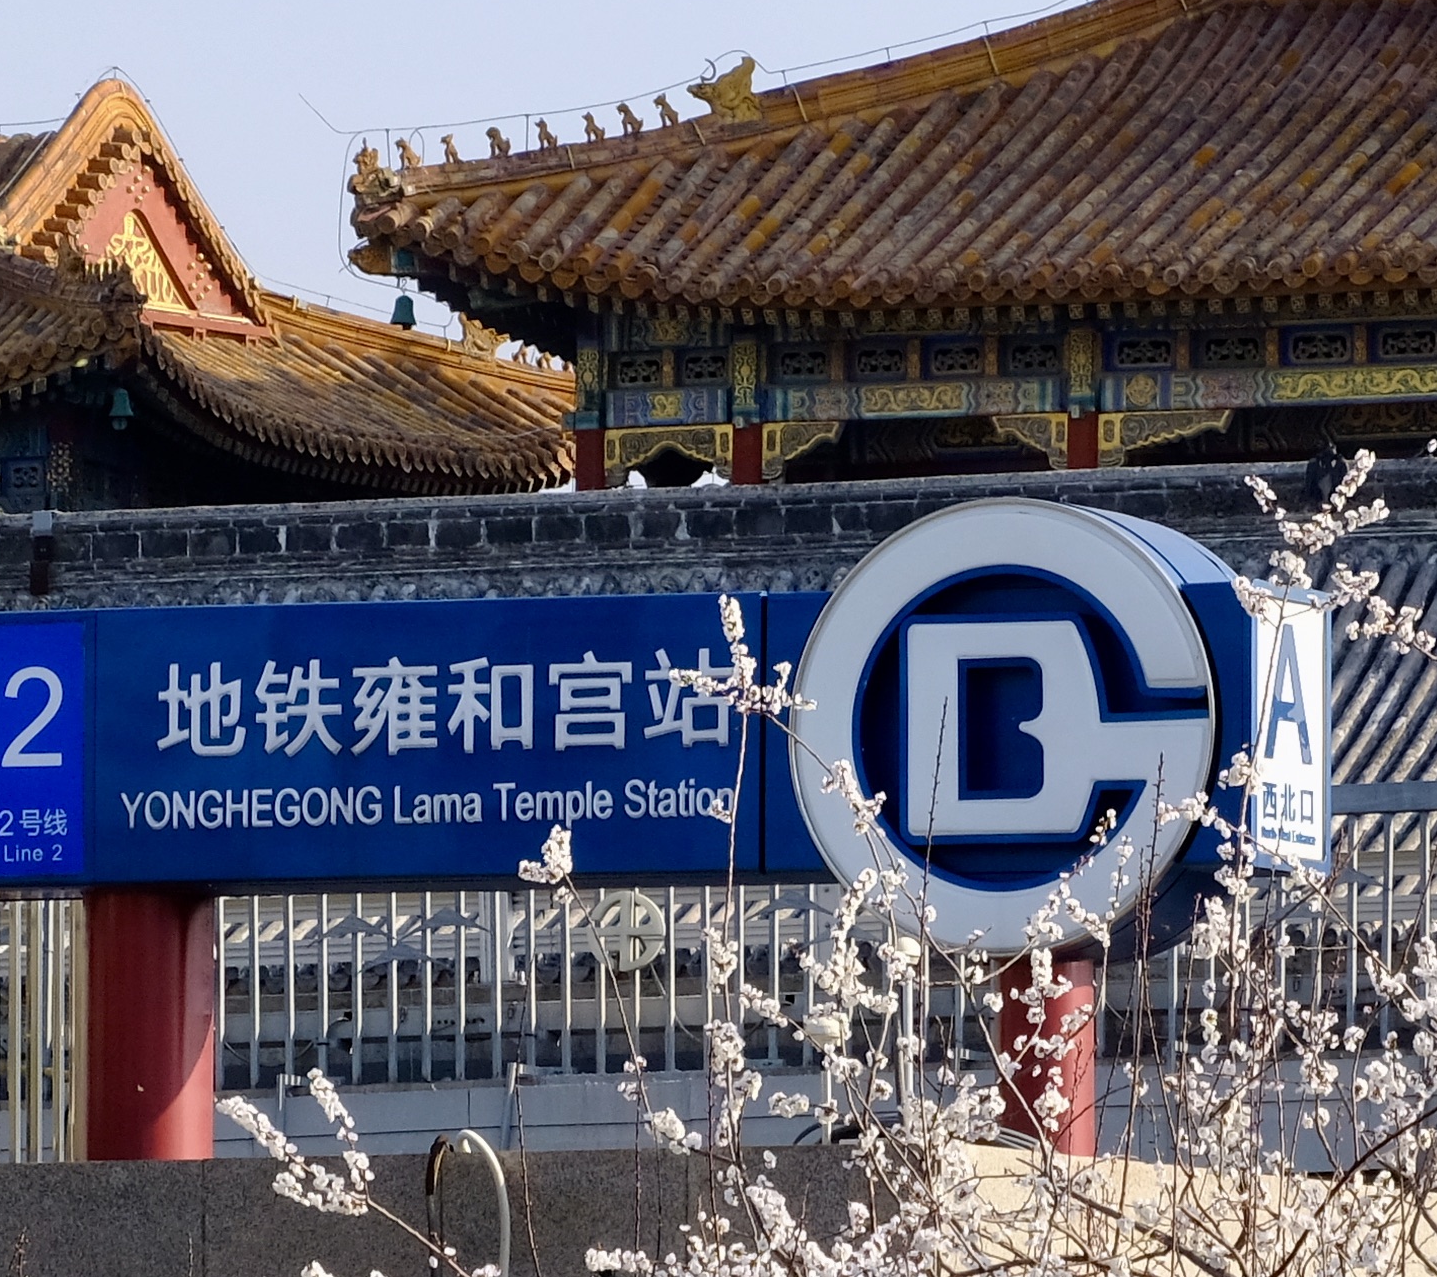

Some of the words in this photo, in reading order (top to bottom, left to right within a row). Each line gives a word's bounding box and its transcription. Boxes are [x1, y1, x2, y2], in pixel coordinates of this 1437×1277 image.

[1, 666, 63, 767] 2
[156, 647, 736, 757] 地铁雍和宫站
[1264, 624, 1313, 765] A
[120, 785, 383, 830] YONGHEGONG
[393, 785, 482, 824] Lama
[492, 780, 613, 829] Temple
[623, 778, 734, 819] Station
[1262, 782, 1313, 824] 西北口
[3, 845, 43, 863] Line
[52, 844, 63, 861] 2
